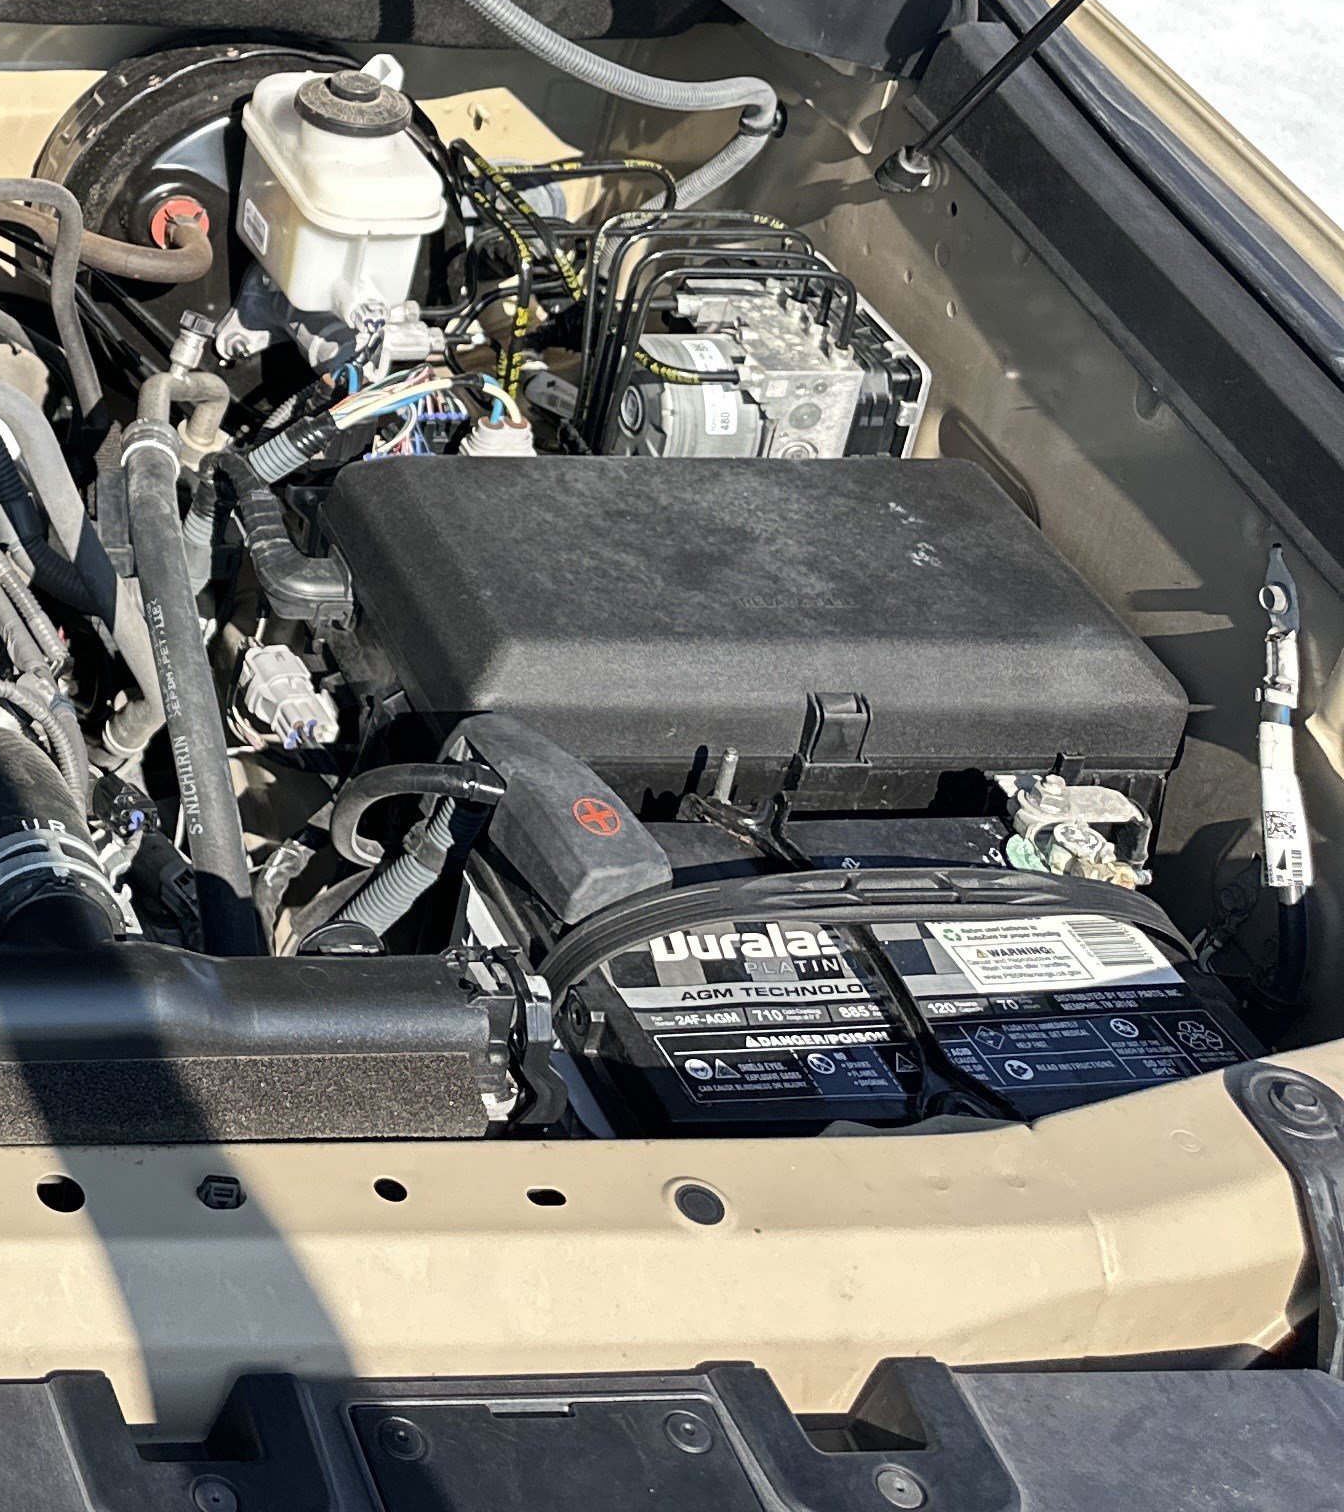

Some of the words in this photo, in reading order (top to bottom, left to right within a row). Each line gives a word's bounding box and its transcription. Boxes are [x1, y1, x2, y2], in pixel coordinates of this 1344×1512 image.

[649, 923, 844, 962] Duralas
[986, 946, 1055, 958] WARNING:
[681, 988, 734, 1002] AGM
[927, 1002, 957, 1014] 120
[996, 999, 1019, 1010] 70
[674, 1011, 741, 1026] 24F-AGM
[752, 1008, 783, 1022] 710
[839, 1005, 870, 1019] 885
